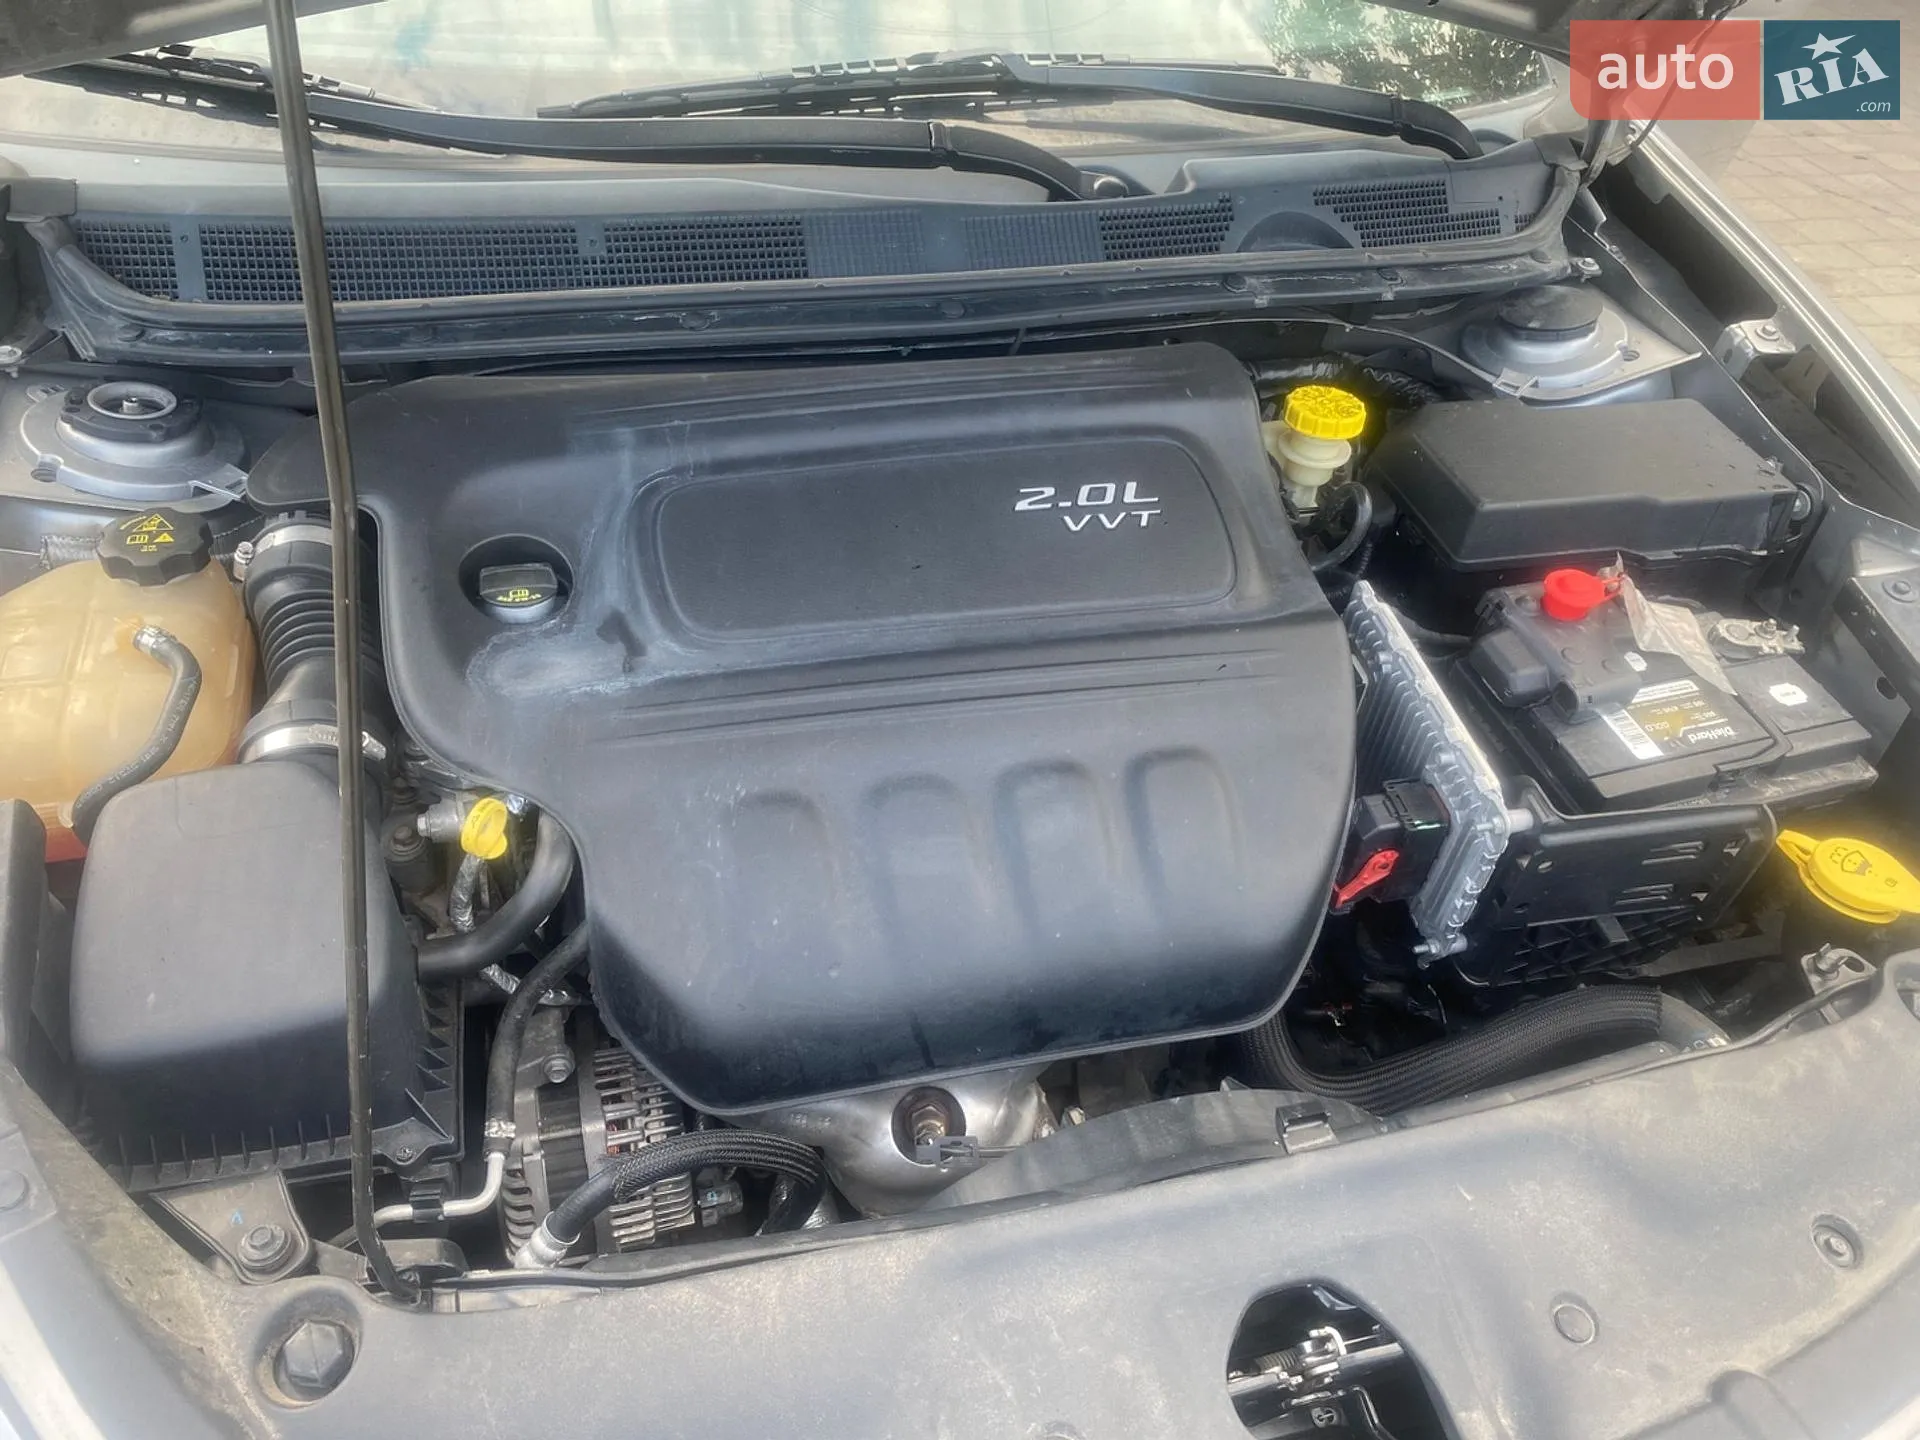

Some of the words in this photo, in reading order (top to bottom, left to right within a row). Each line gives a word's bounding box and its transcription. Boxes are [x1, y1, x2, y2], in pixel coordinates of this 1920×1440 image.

[1014, 482, 1160, 511] 2.0L
[1063, 510, 1161, 532] VVT
[1687, 725, 1735, 744] DieHard
